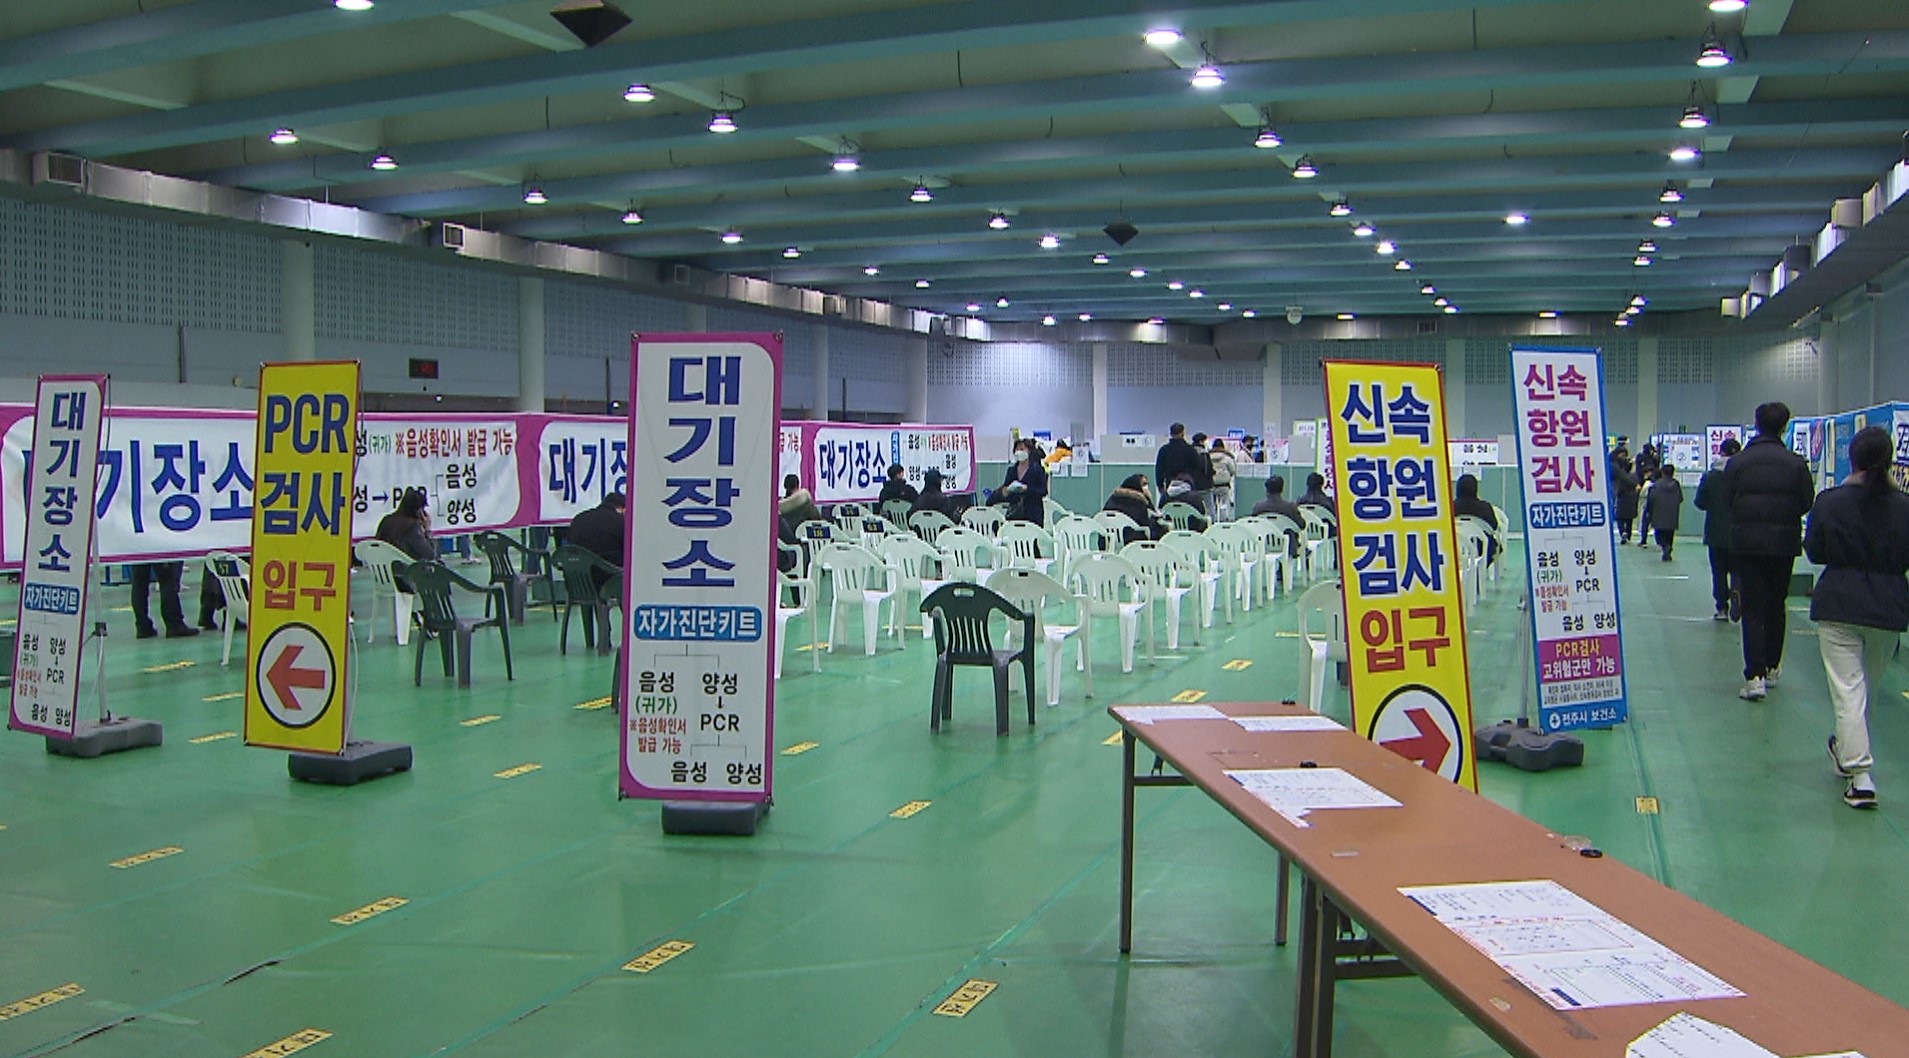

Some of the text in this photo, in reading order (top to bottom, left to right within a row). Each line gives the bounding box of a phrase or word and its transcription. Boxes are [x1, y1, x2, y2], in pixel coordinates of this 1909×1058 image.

[1524, 364, 1587, 401] 신속
[264, 394, 349, 454] PCR
[1341, 383, 1430, 444] 신속
[468, 428, 487, 457] 발급
[493, 428, 513, 457] 가능
[1527, 409, 1591, 448] 항원
[446, 462, 477, 490] 음성
[662, 356, 741, 587] 대기장소
[819, 440, 887, 489] 대기장소
[1531, 456, 1594, 493] 검사
[38, 392, 87, 573] 대기장소
[1347, 458, 1438, 519] 항원
[261, 472, 345, 536] 검사
[447, 497, 477, 525] 양성
[1532, 505, 1603, 526] 자가진단키트
[1353, 531, 1444, 596] 검사
[1537, 549, 1596, 568] 음성 양성
[25, 586, 78, 613] 자가진단키트
[263, 560, 337, 611] 입구
[1576, 578, 1600, 593] PCR
[638, 607, 757, 638] 자가진단키트
[1562, 612, 1615, 631] 음성 양성
[1360, 606, 1450, 673] 입구
[1556, 638, 1599, 658] PCR검사
[46, 668, 65, 685] PCR
[1543, 655, 1615, 679] 고위험군만 가능
[639, 671, 738, 695] 음성 양성
[635, 696, 677, 714] (귀가)
[1591, 707, 1617, 721] 보건소
[700, 714, 740, 732] PCR
[638, 737, 681, 754] 발급 가능
[671, 761, 762, 785] 음성 양성
